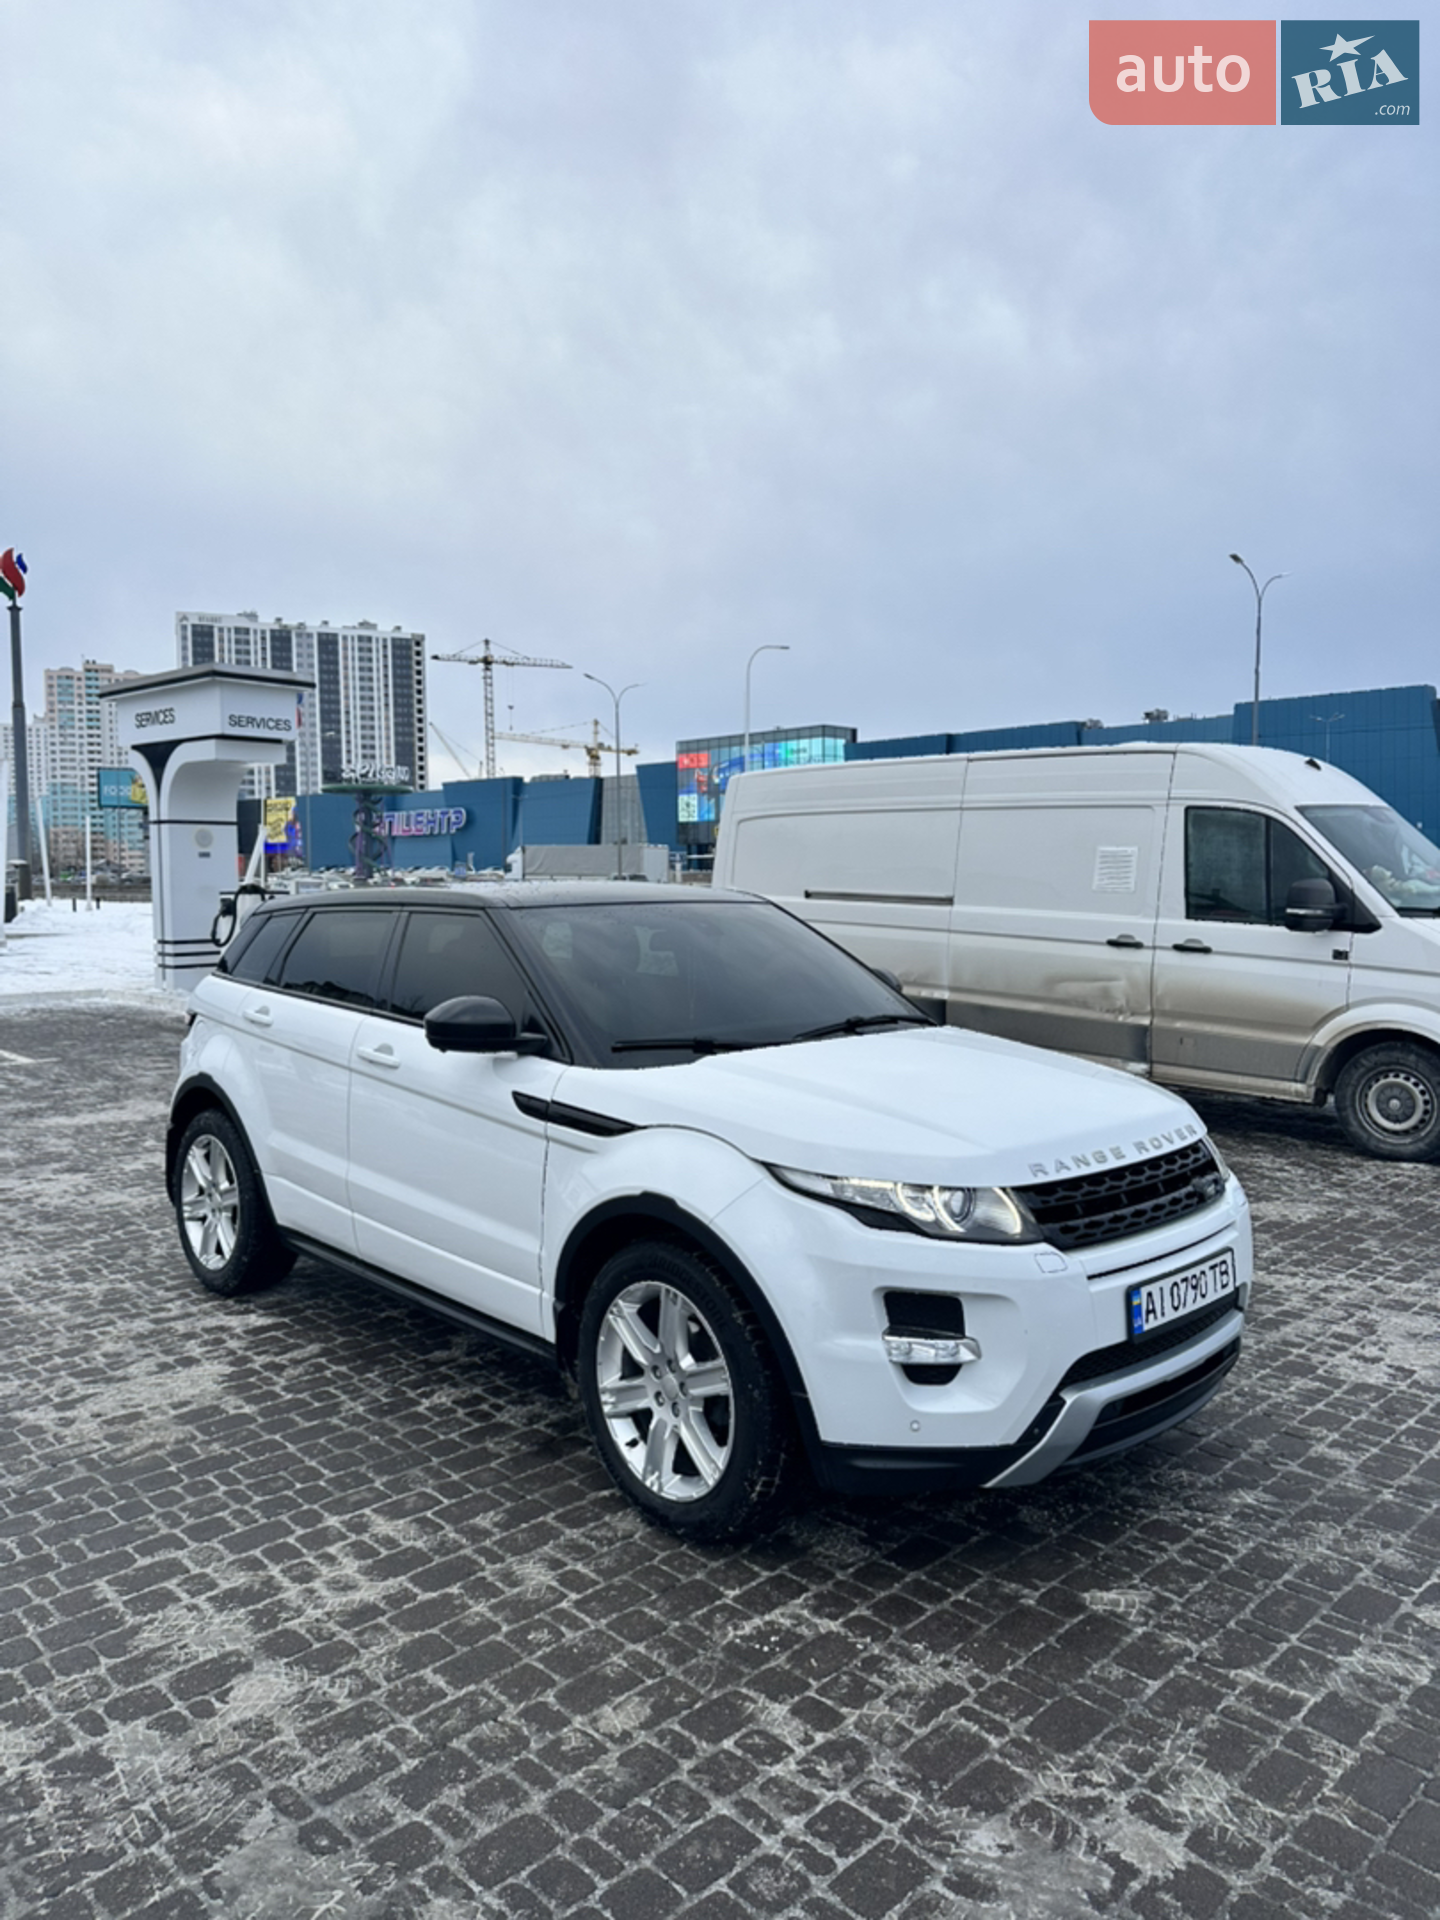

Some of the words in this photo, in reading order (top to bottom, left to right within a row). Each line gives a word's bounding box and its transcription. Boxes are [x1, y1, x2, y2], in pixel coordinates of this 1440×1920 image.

[134, 707, 176, 729] SERVICES
[228, 713, 292, 732] SERVICES
[1027, 1145, 1127, 1178] RANGE
[1132, 1123, 1199, 1155] ROVER
[1144, 1286, 1166, 1324] AI
[1169, 1269, 1208, 1313] 0790
[1208, 1259, 1231, 1293] TB
